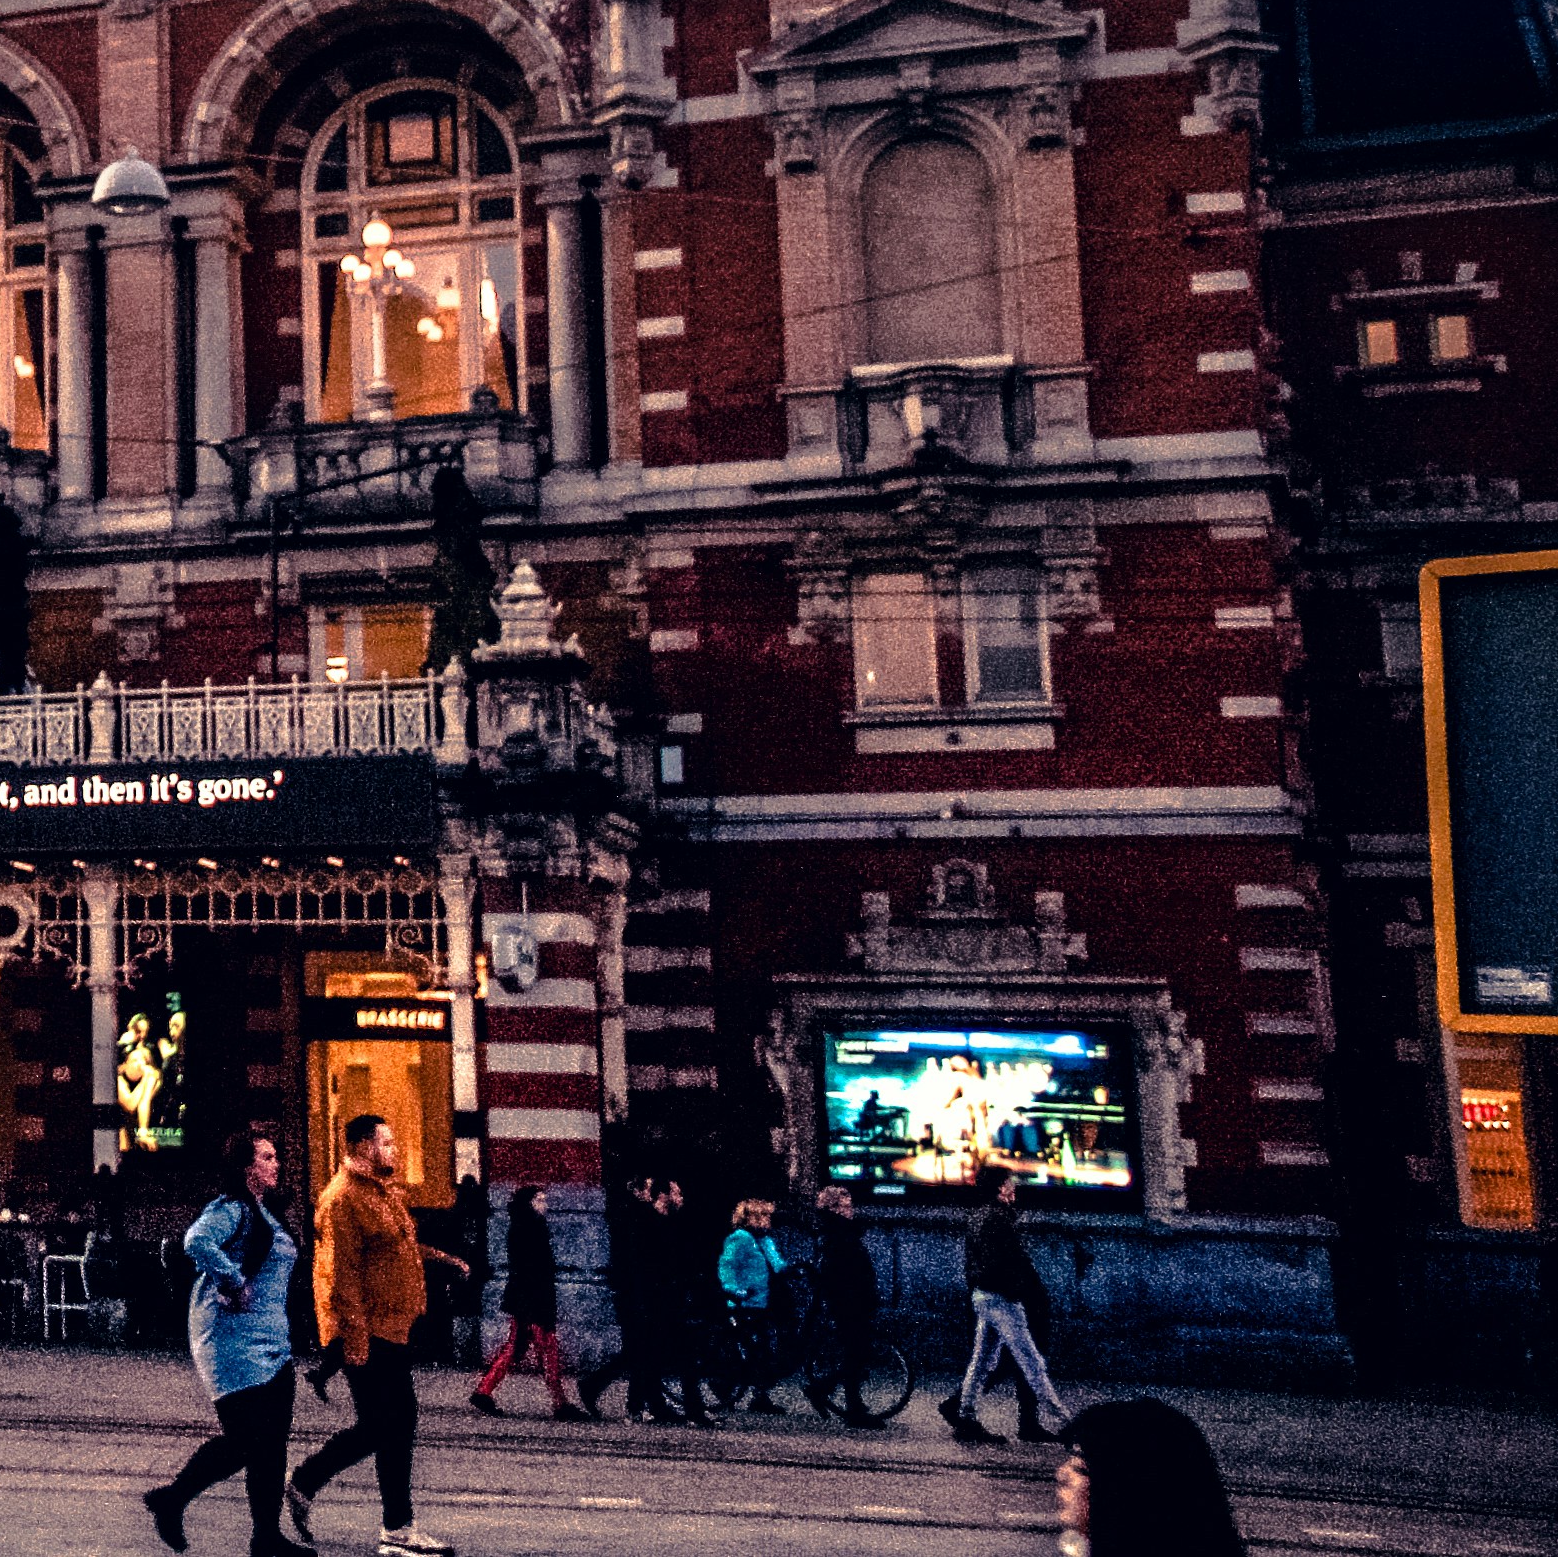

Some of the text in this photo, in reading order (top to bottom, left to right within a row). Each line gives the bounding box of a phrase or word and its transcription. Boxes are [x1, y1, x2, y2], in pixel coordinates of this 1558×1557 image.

[23, 776, 79, 808] and
[82, 775, 145, 806] then
[356, 1008, 445, 1030] BRASSERIE
